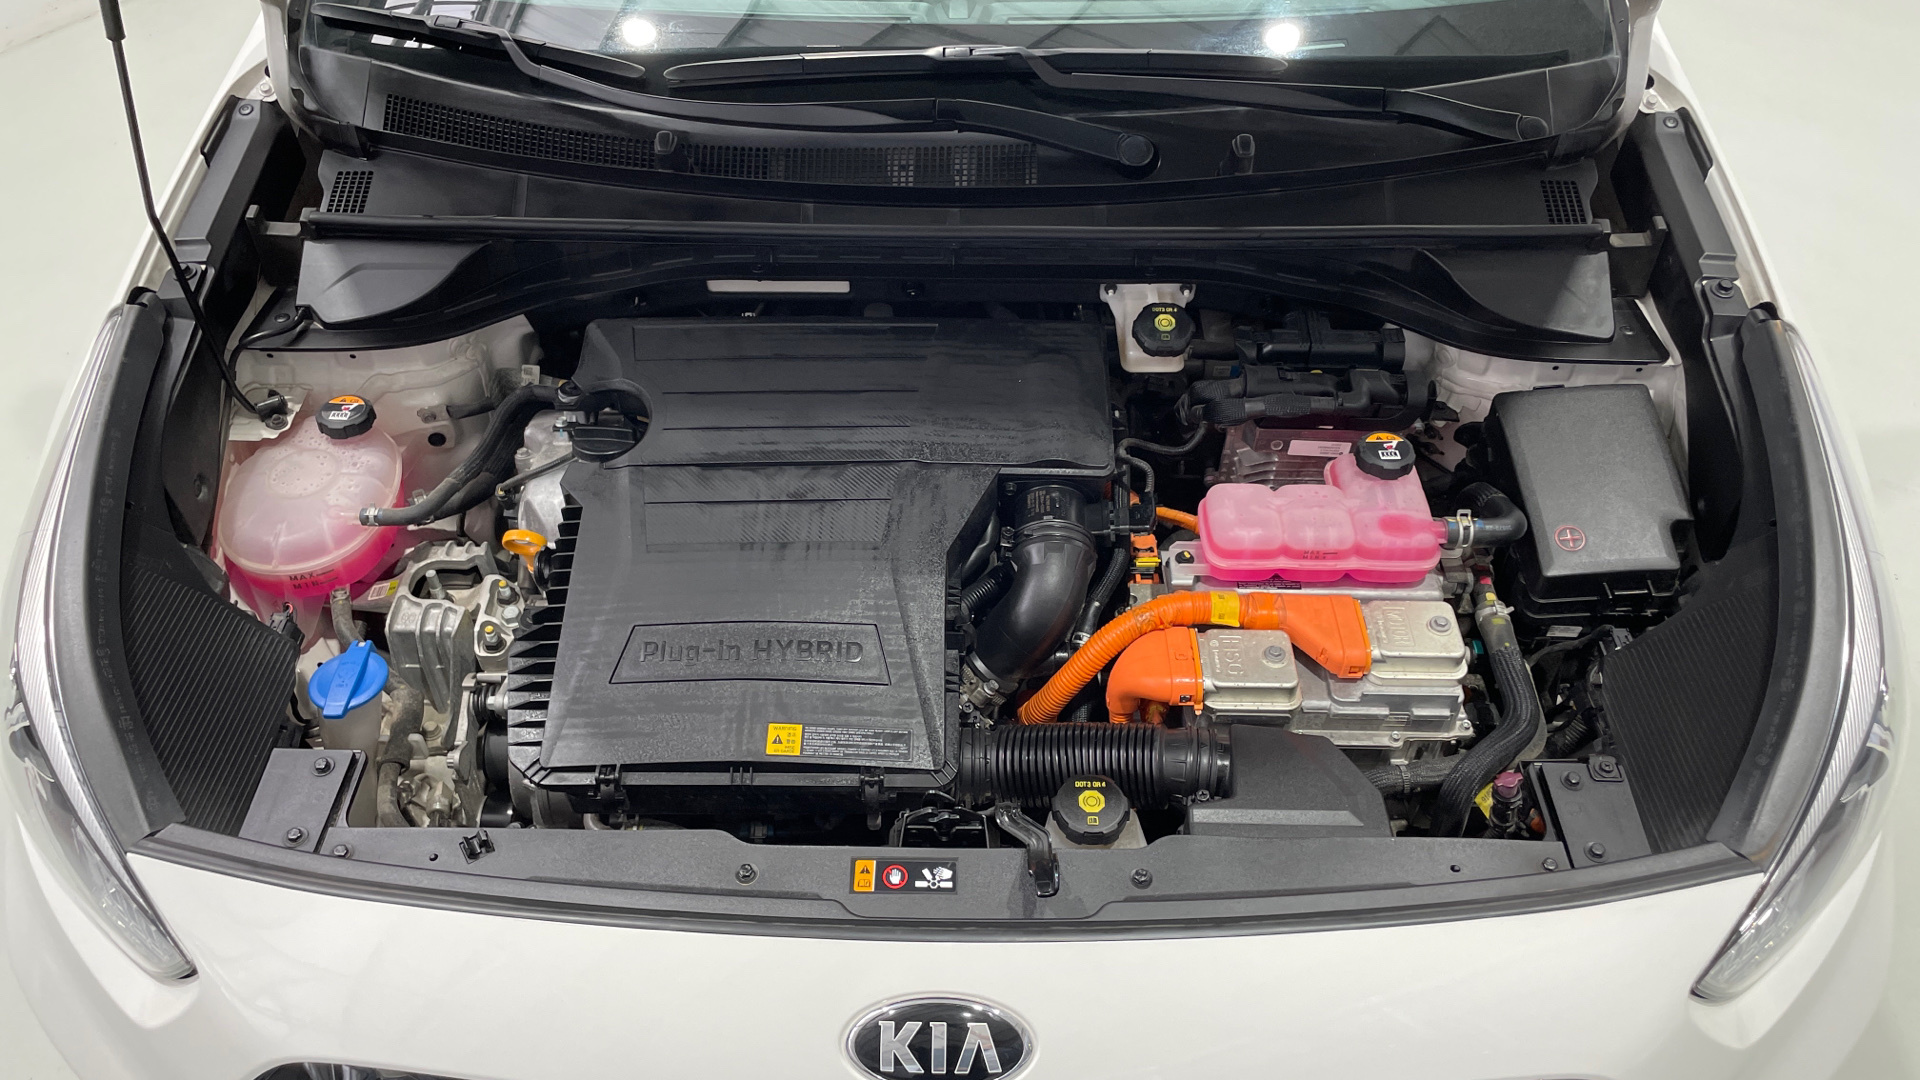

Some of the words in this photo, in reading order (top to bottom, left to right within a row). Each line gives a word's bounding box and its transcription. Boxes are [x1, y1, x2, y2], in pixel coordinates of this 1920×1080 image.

[289, 572, 314, 581] MAX
[292, 580, 320, 590] MIN
[640, 639, 740, 667] Plug-in
[752, 638, 865, 663] HYBRID
[878, 1020, 1003, 1074] KIA
